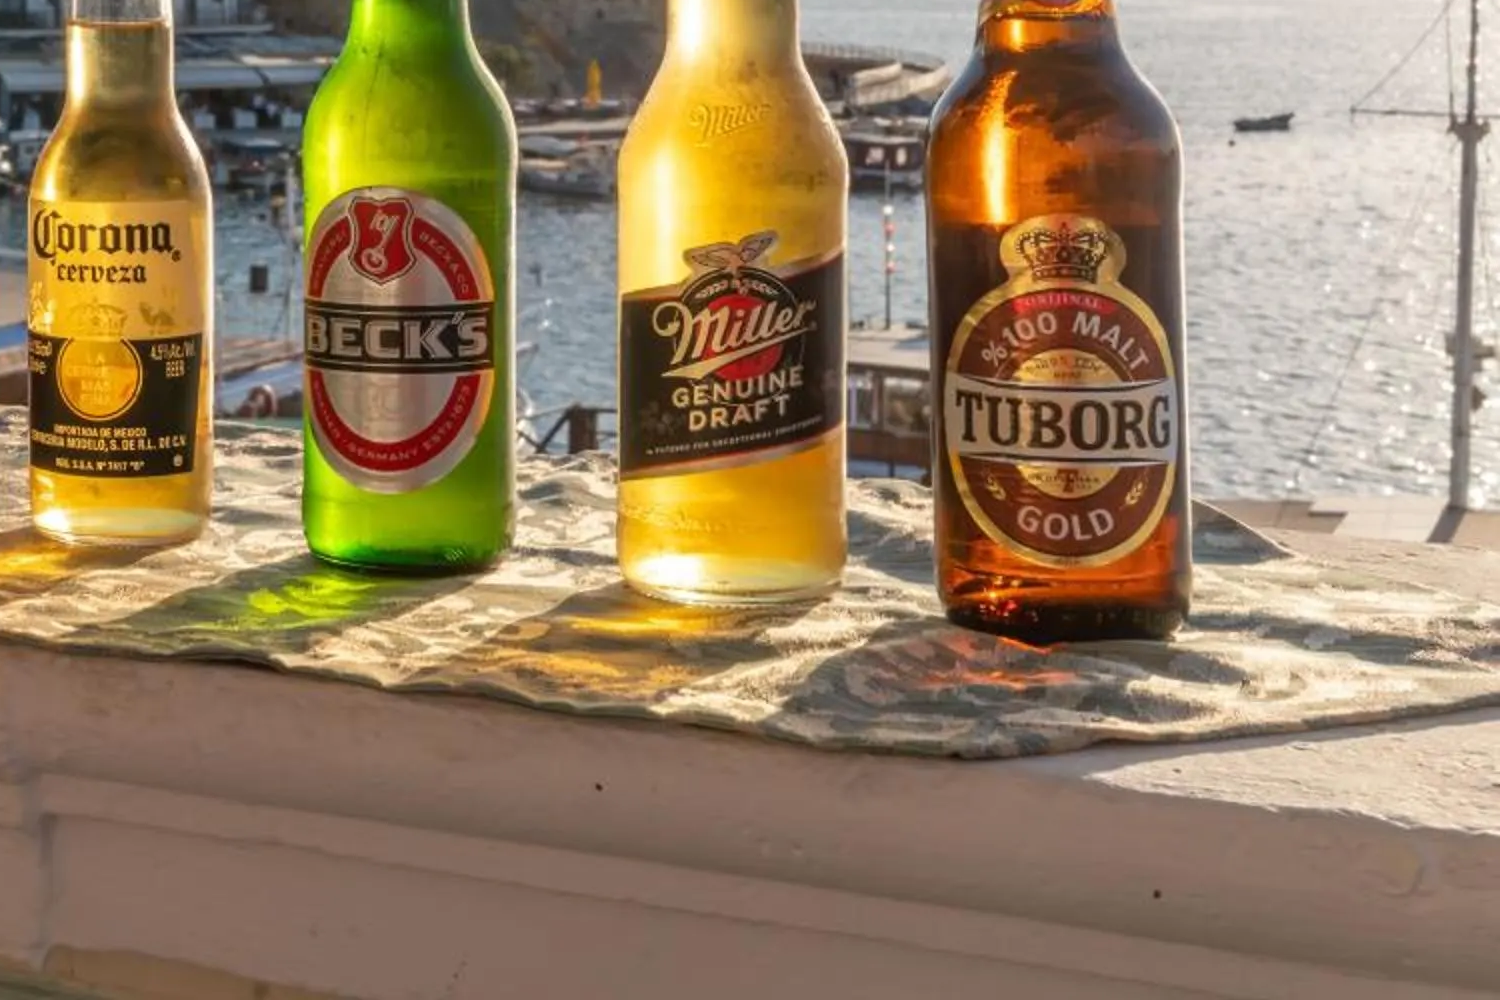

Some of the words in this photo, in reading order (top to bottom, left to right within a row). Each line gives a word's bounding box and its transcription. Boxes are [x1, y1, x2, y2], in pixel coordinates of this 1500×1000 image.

[689, 104, 772, 142] Miller
[33, 209, 174, 262] Corona
[57, 262, 147, 284] cerveza
[307, 311, 488, 360] BECK'S
[651, 300, 817, 366] Miller
[981, 311, 1058, 367] %100
[1072, 311, 1150, 371] MALT
[671, 365, 804, 409] GENUINE
[688, 393, 791, 432] DRAFT
[955, 389, 1170, 451] TUBORG
[121, 440, 135, 450] DE
[1016, 505, 1115, 541] GOLD
